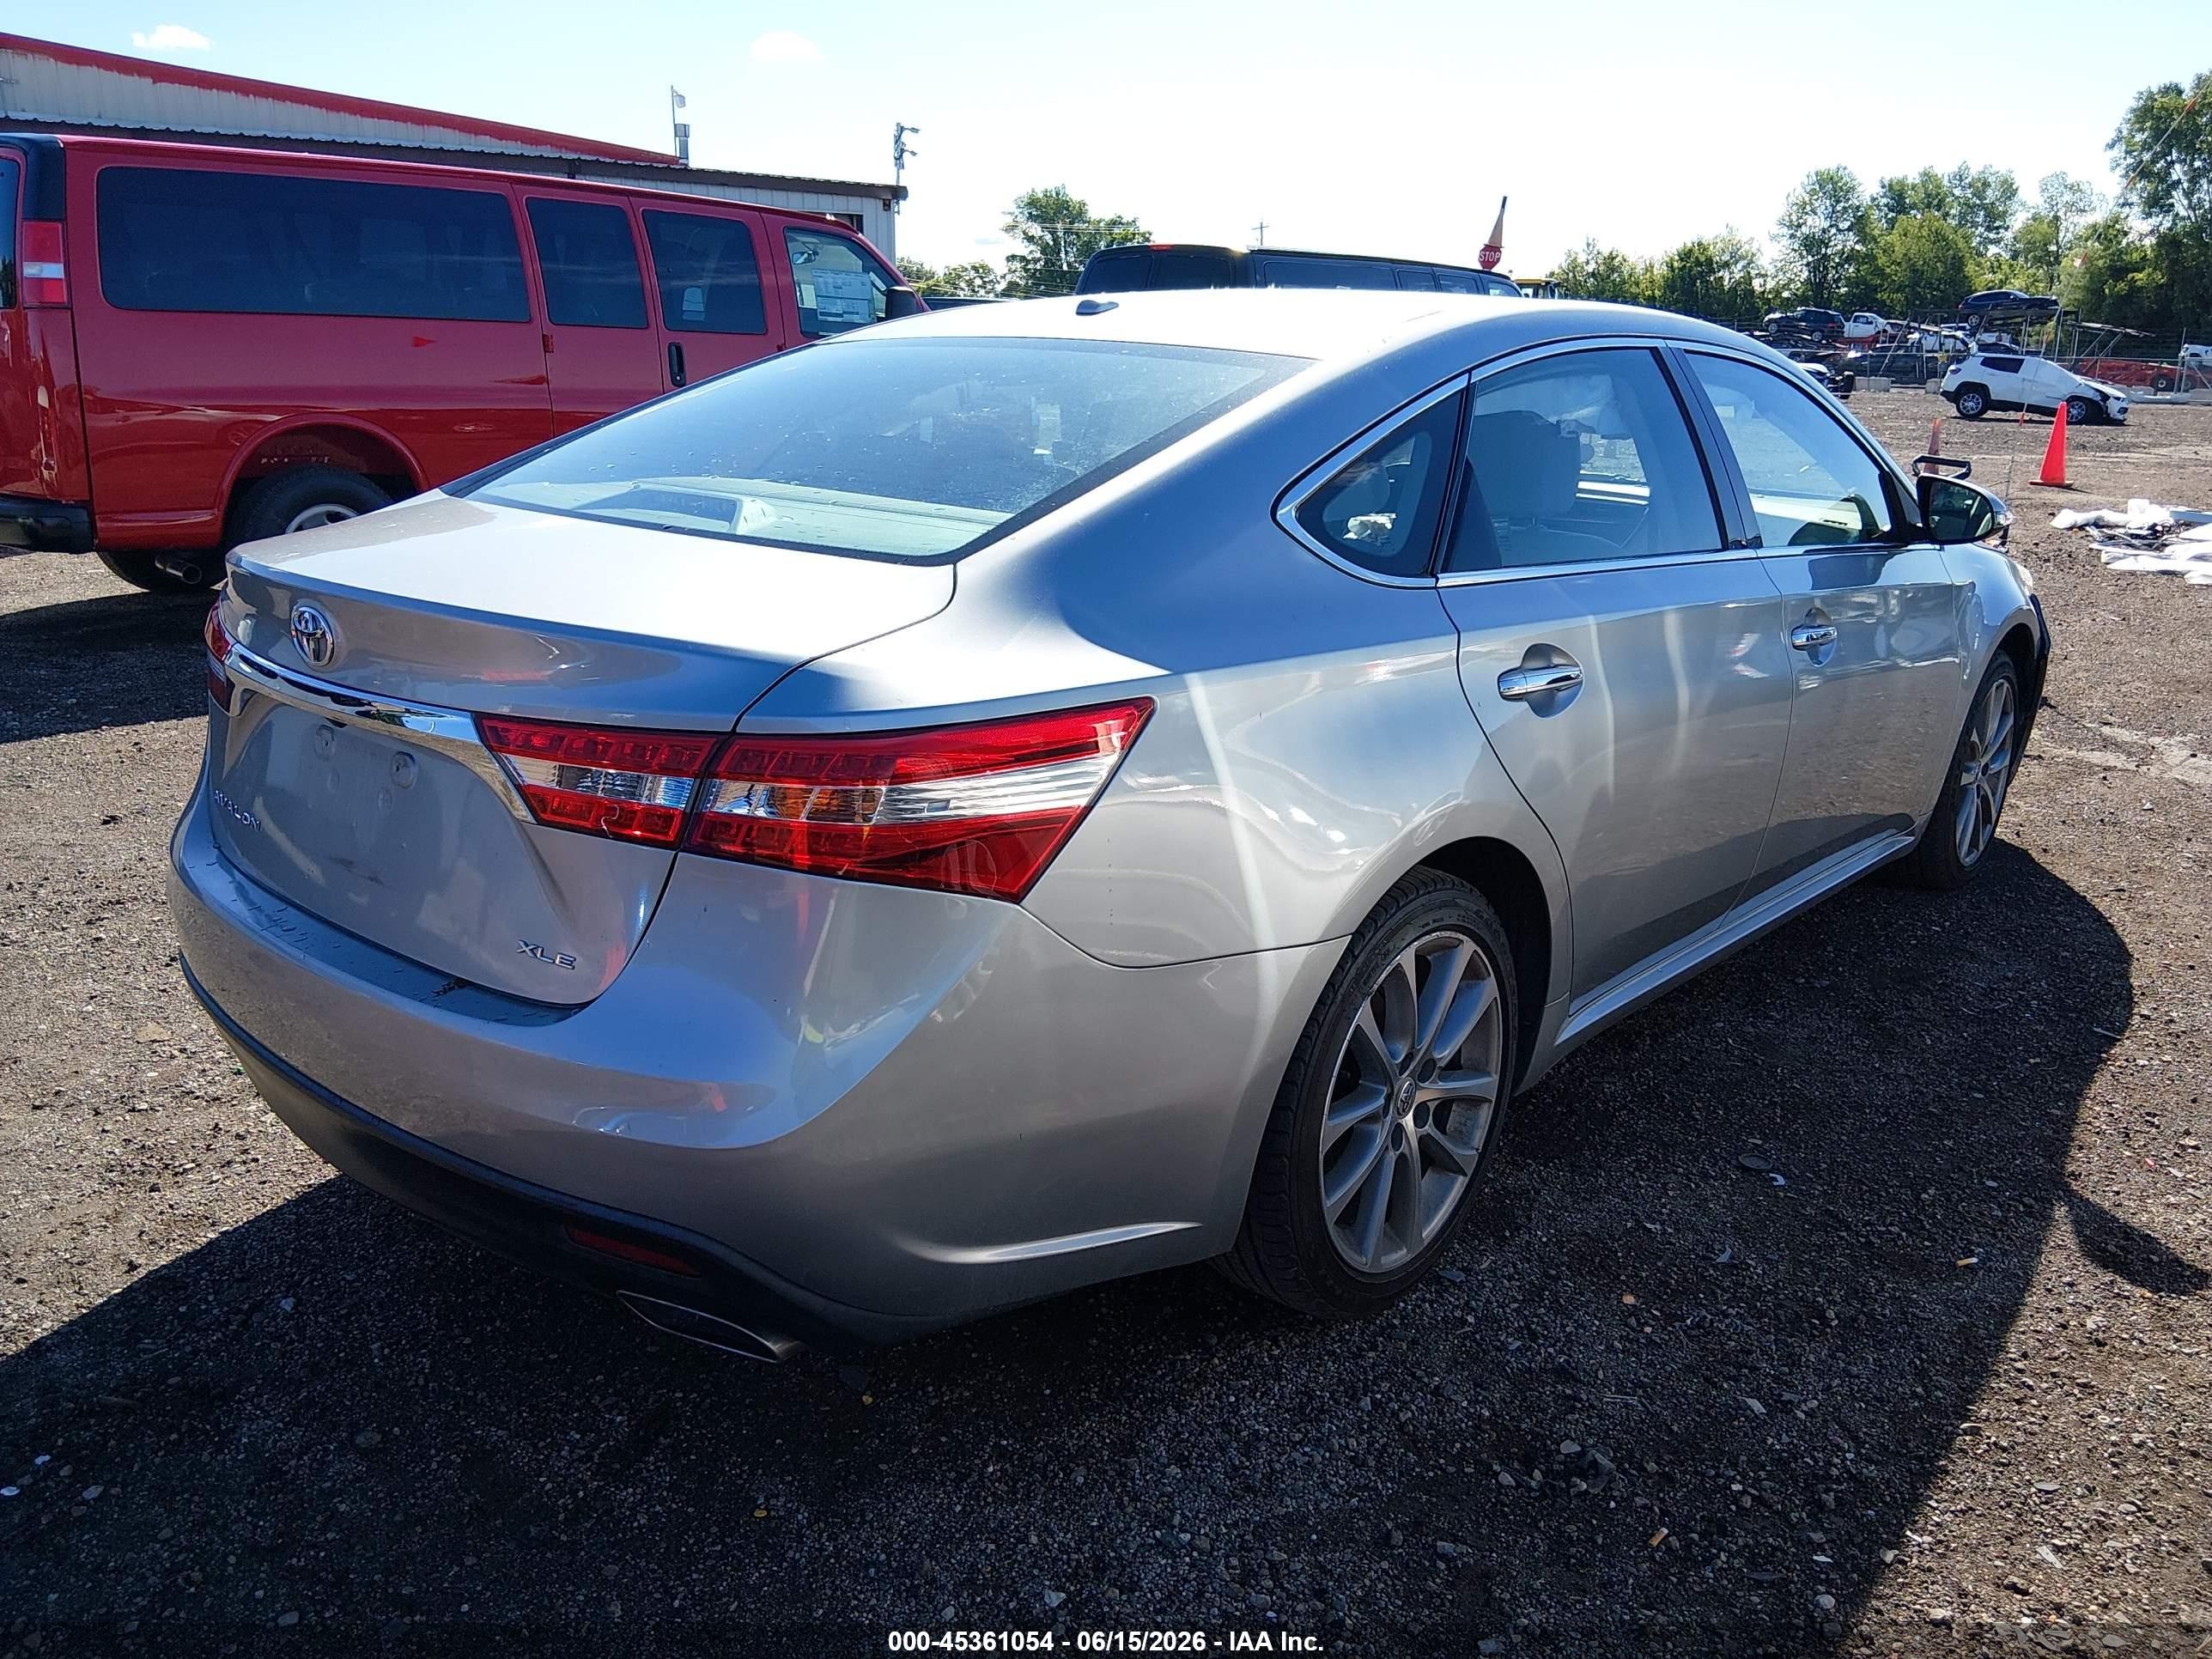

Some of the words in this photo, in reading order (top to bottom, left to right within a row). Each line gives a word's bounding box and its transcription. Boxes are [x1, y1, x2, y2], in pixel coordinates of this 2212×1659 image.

[1479, 251, 1501, 262] STOP
[214, 789, 262, 832] AVALON
[515, 939, 576, 970] XLE
